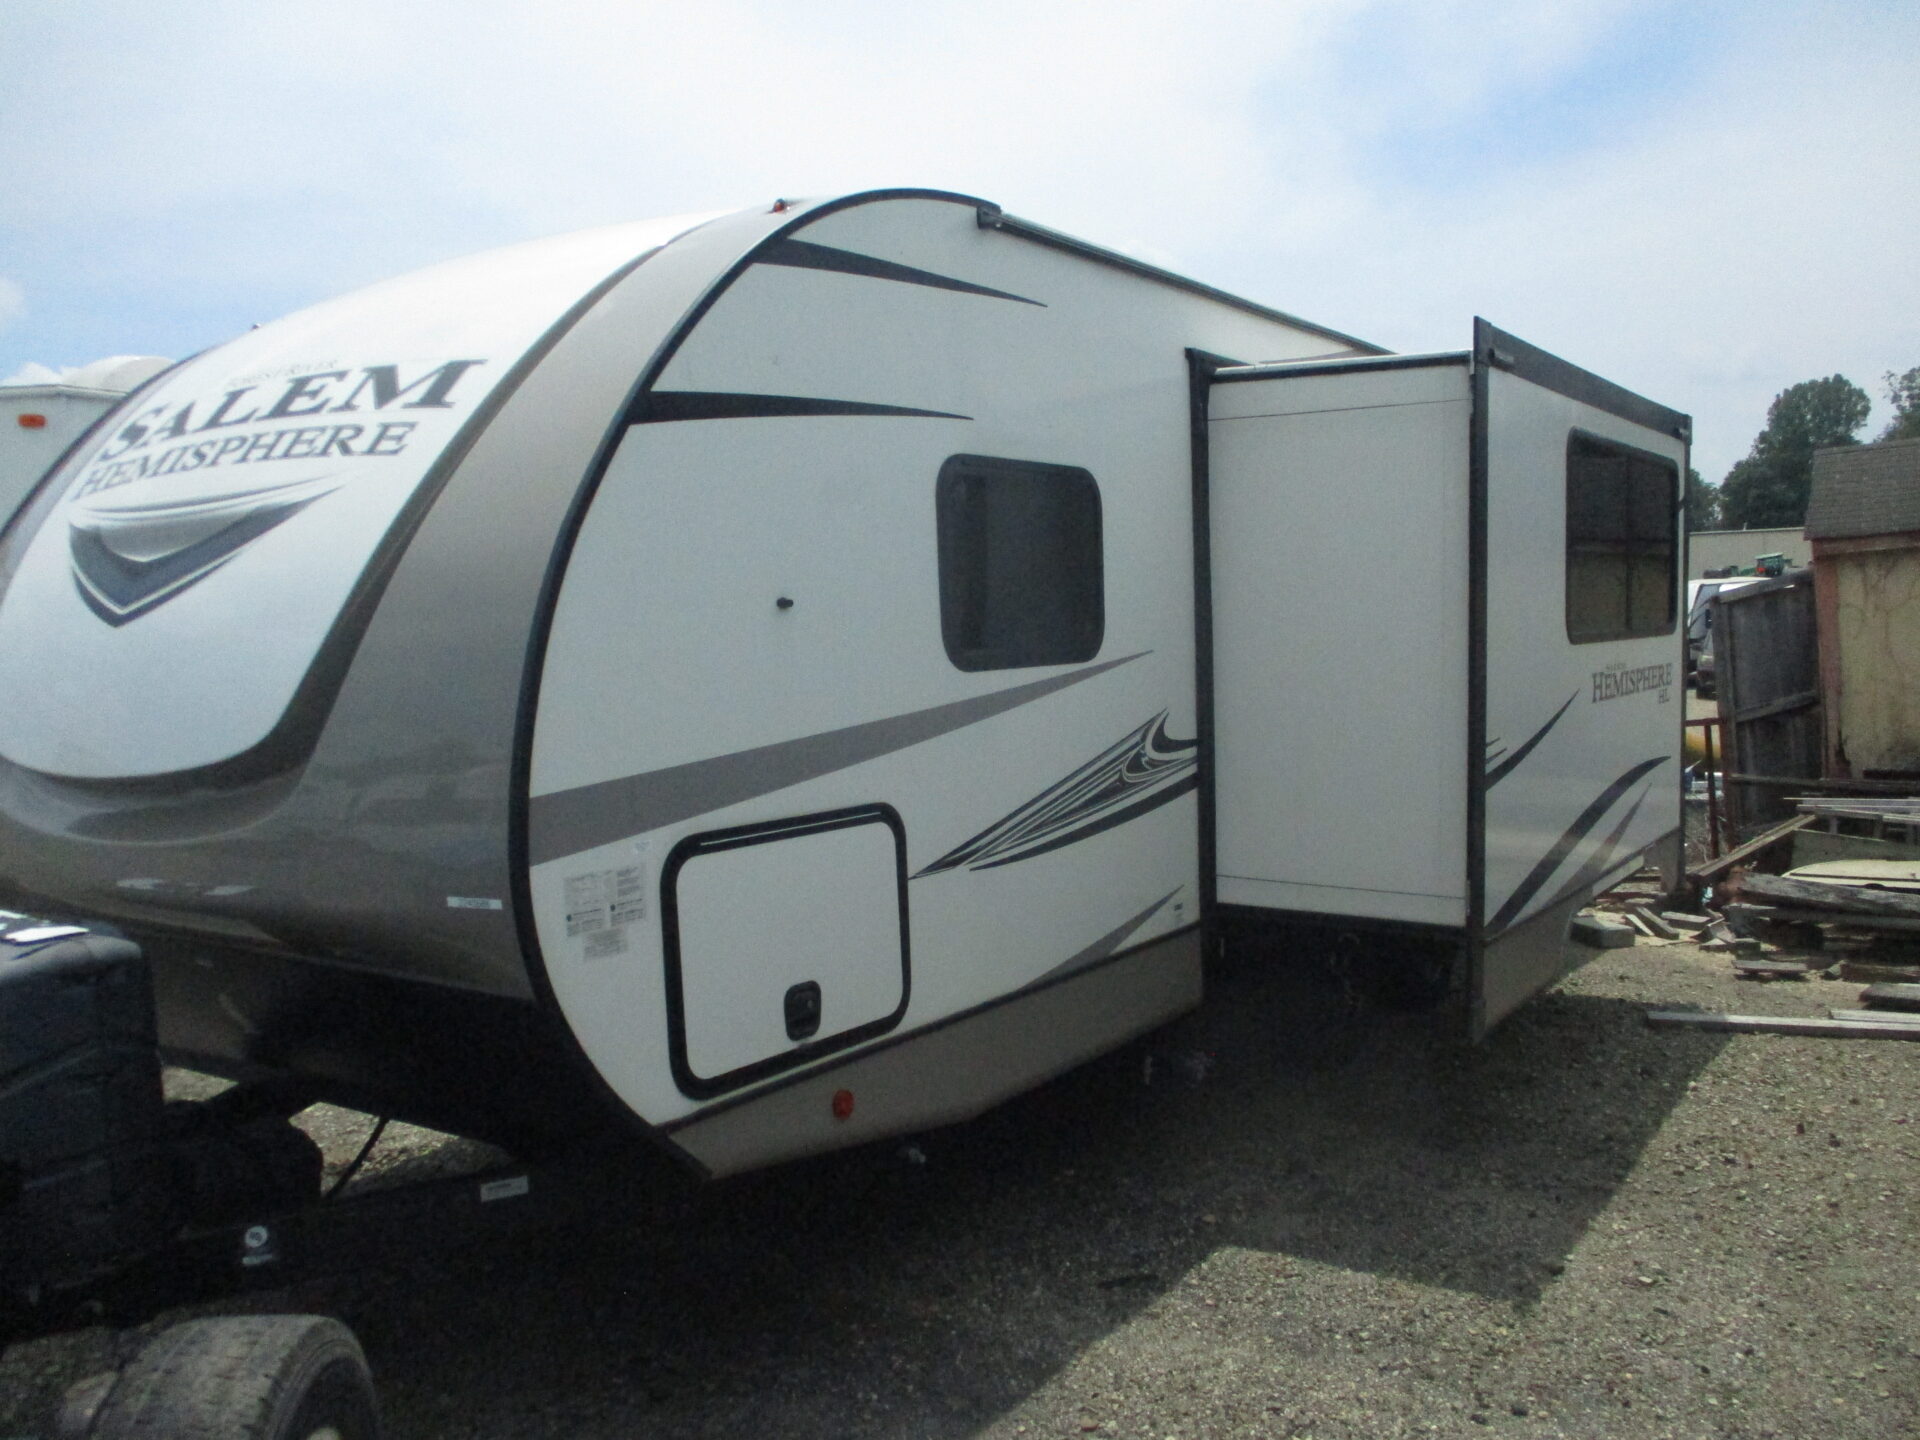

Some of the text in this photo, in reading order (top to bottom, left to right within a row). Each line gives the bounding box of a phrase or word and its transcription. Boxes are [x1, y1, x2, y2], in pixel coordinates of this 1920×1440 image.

[102, 358, 486, 461] SALEM
[79, 421, 418, 496] HEMISPHERE
[1591, 663, 1672, 703] HEMISPHERE
